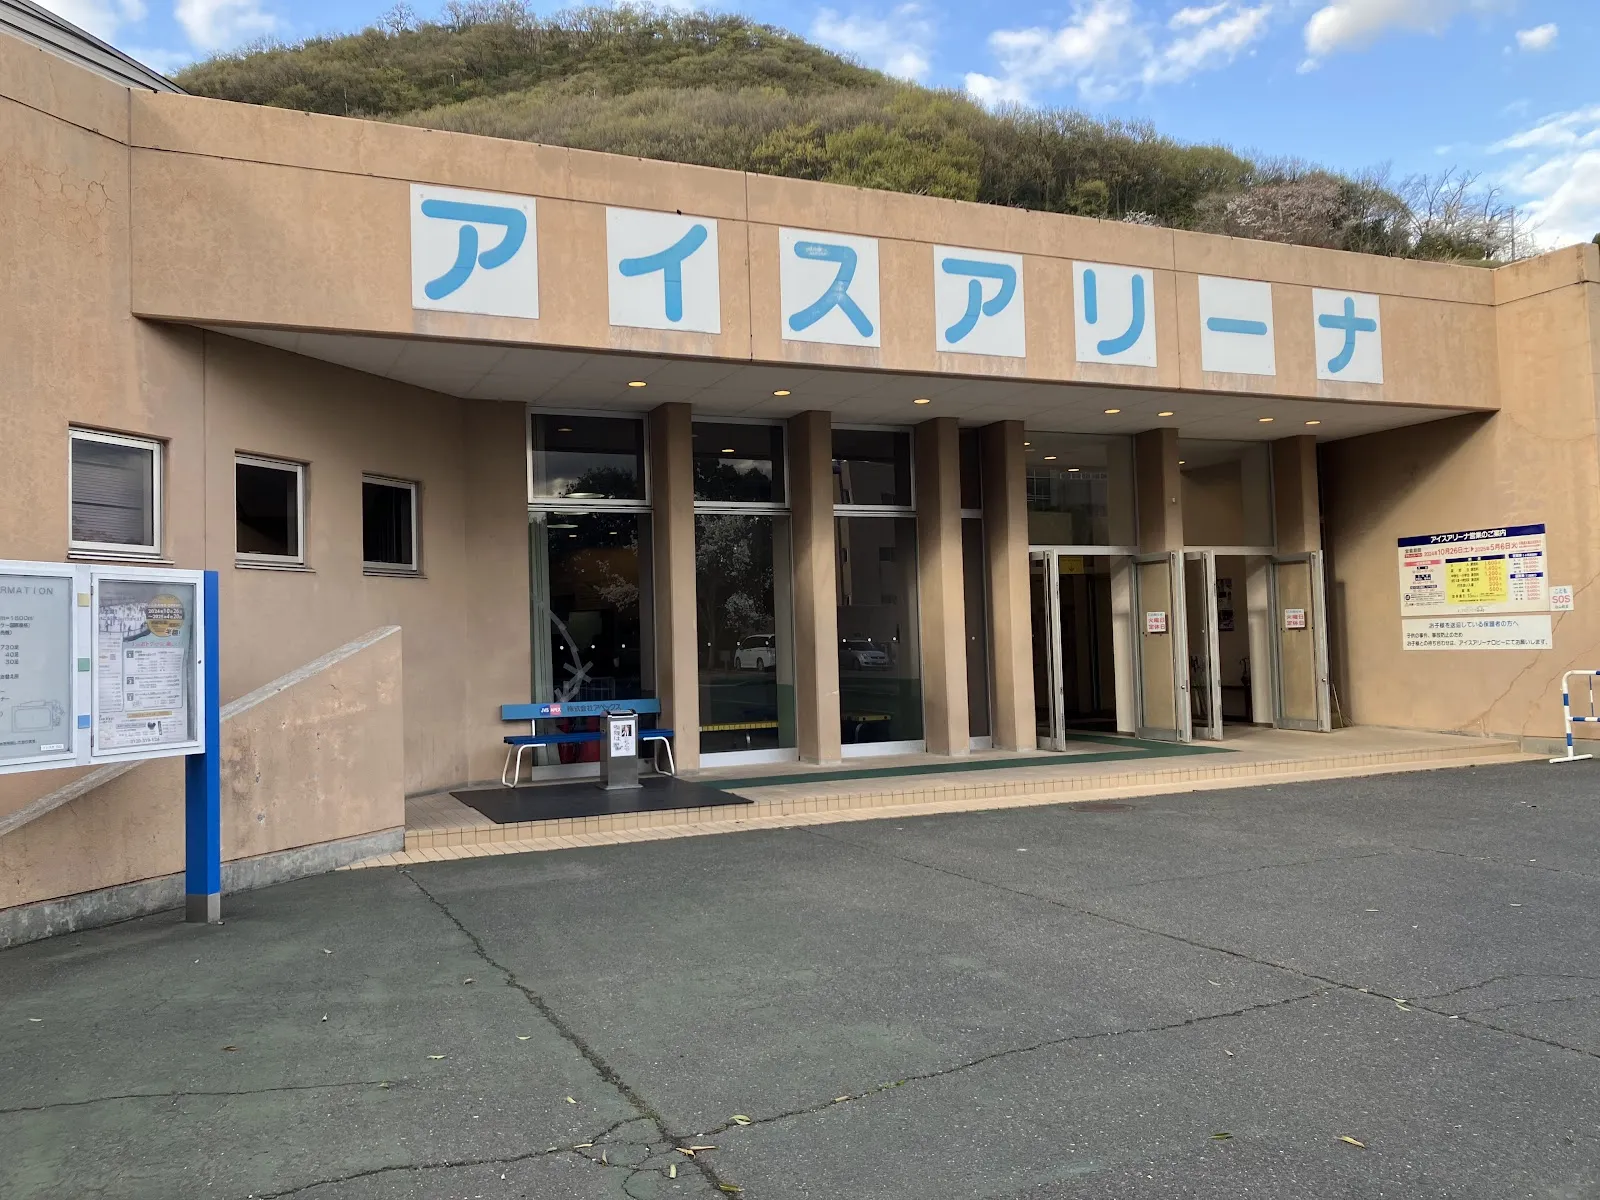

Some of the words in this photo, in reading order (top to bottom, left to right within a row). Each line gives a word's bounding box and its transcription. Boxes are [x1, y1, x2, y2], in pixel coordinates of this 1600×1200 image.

[421, 199, 1376, 373] アイスアリーナ
[1430, 529, 1507, 543] アイスアリーナ営業のご案内
[1552, 594, 1571, 604] SOS
[1428, 619, 1519, 629] お子様を送迎している保護者の方へ
